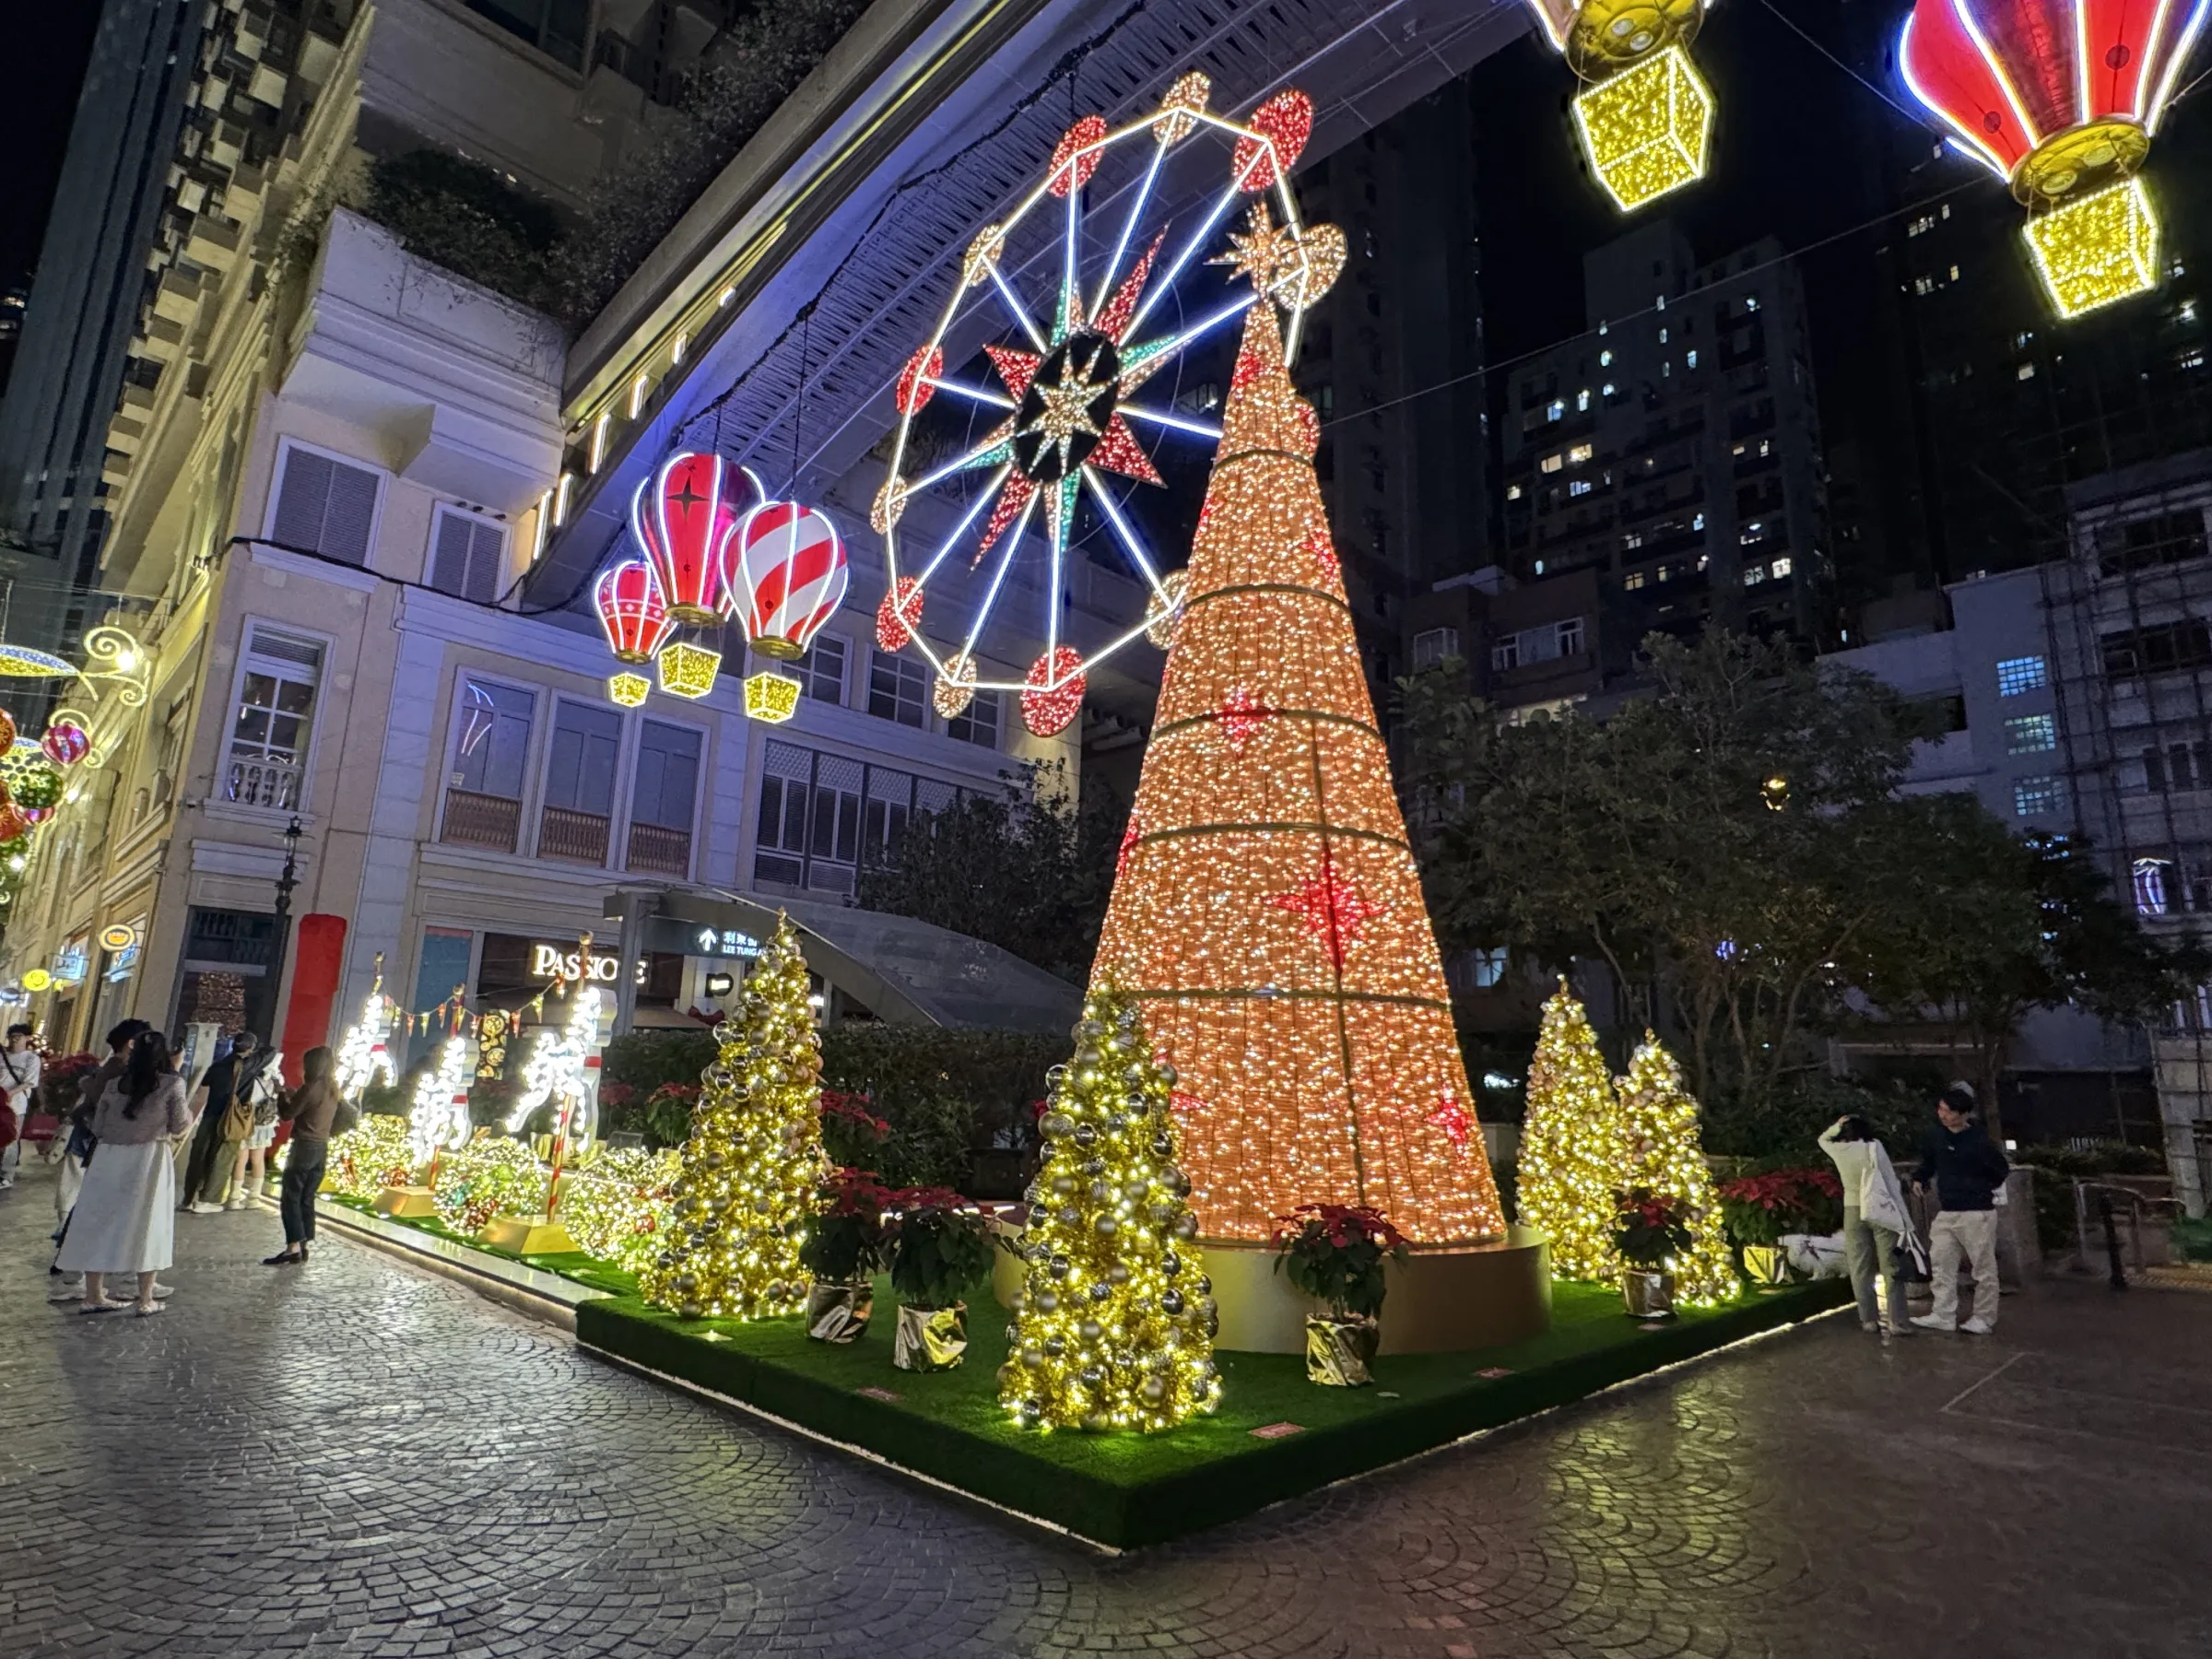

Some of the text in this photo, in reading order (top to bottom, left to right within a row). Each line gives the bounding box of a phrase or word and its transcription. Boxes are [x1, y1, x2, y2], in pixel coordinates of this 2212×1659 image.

[532, 944, 647, 984] PASSIOE
[723, 945, 735, 954] LEE
[736, 946, 757, 957] TUNG
